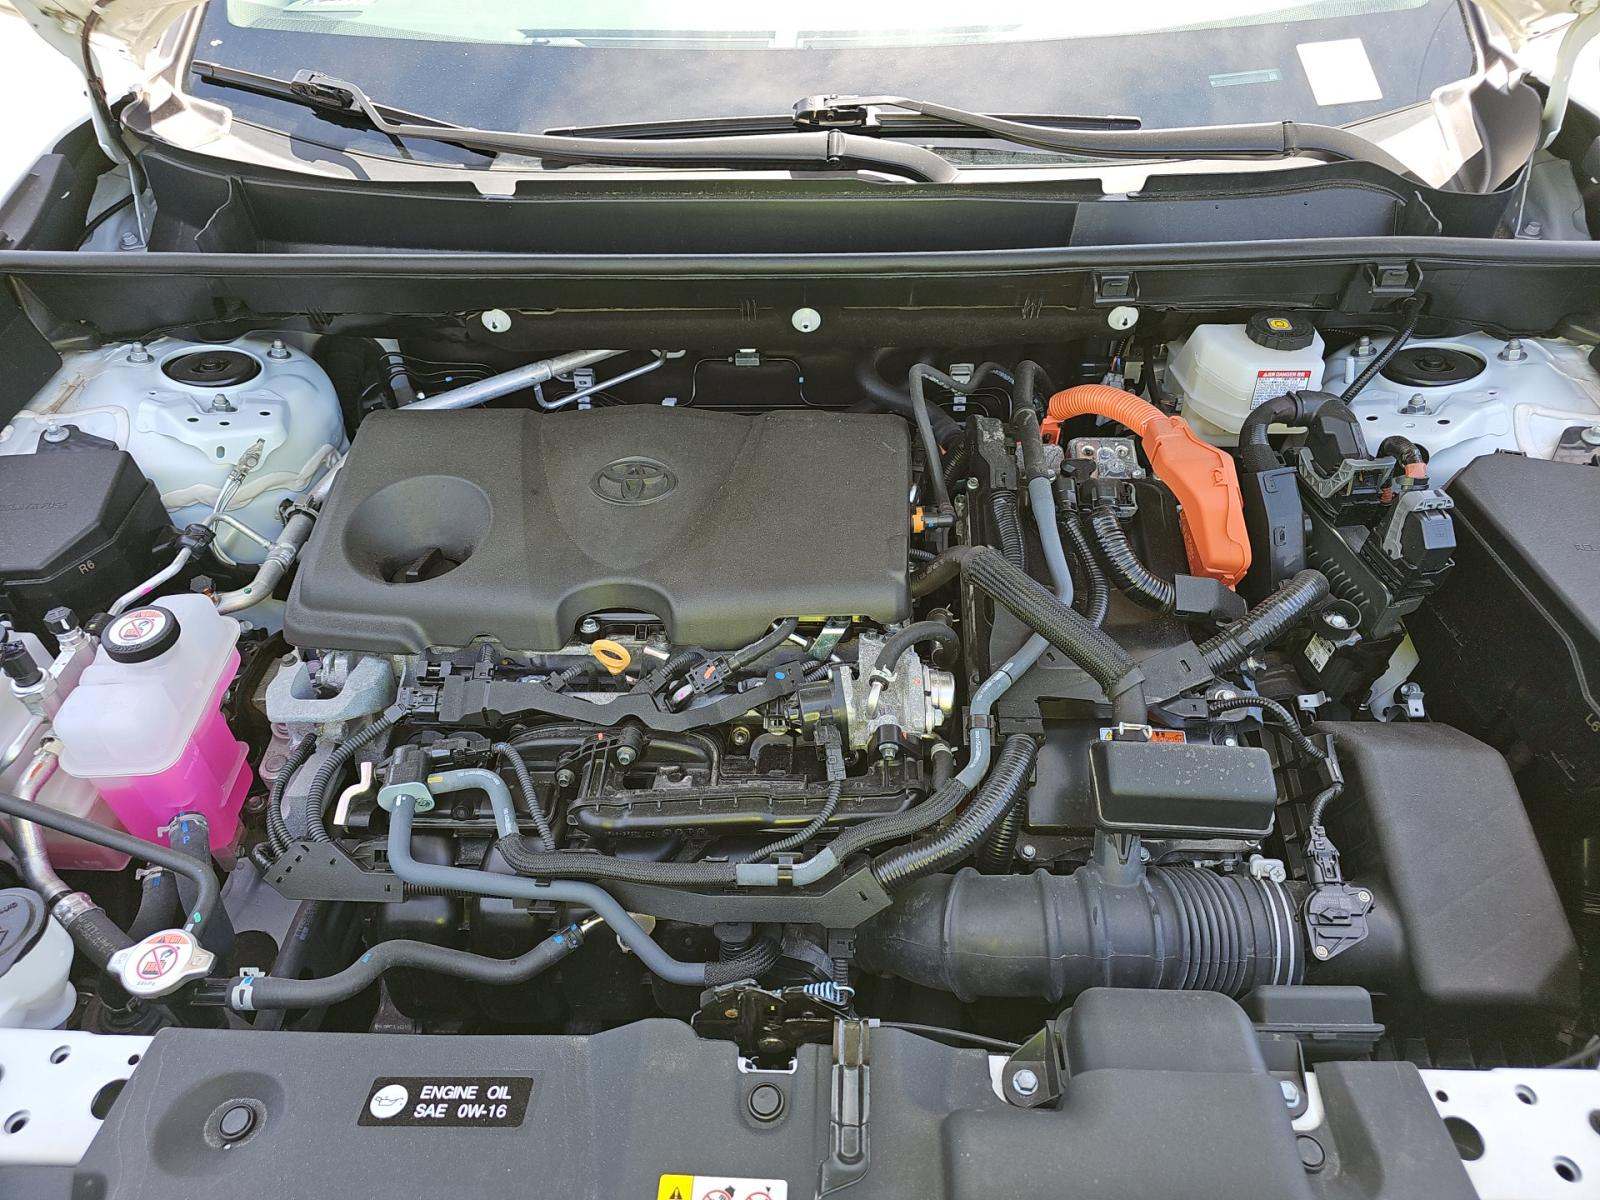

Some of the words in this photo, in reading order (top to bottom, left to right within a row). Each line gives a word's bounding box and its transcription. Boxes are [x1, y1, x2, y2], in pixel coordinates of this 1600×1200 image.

[79, 560, 95, 574] R6
[420, 1085, 479, 1100] ENGINE
[487, 1085, 512, 1100] OIL
[413, 1103, 448, 1118] SAE
[457, 1103, 508, 1119] 0W-16
